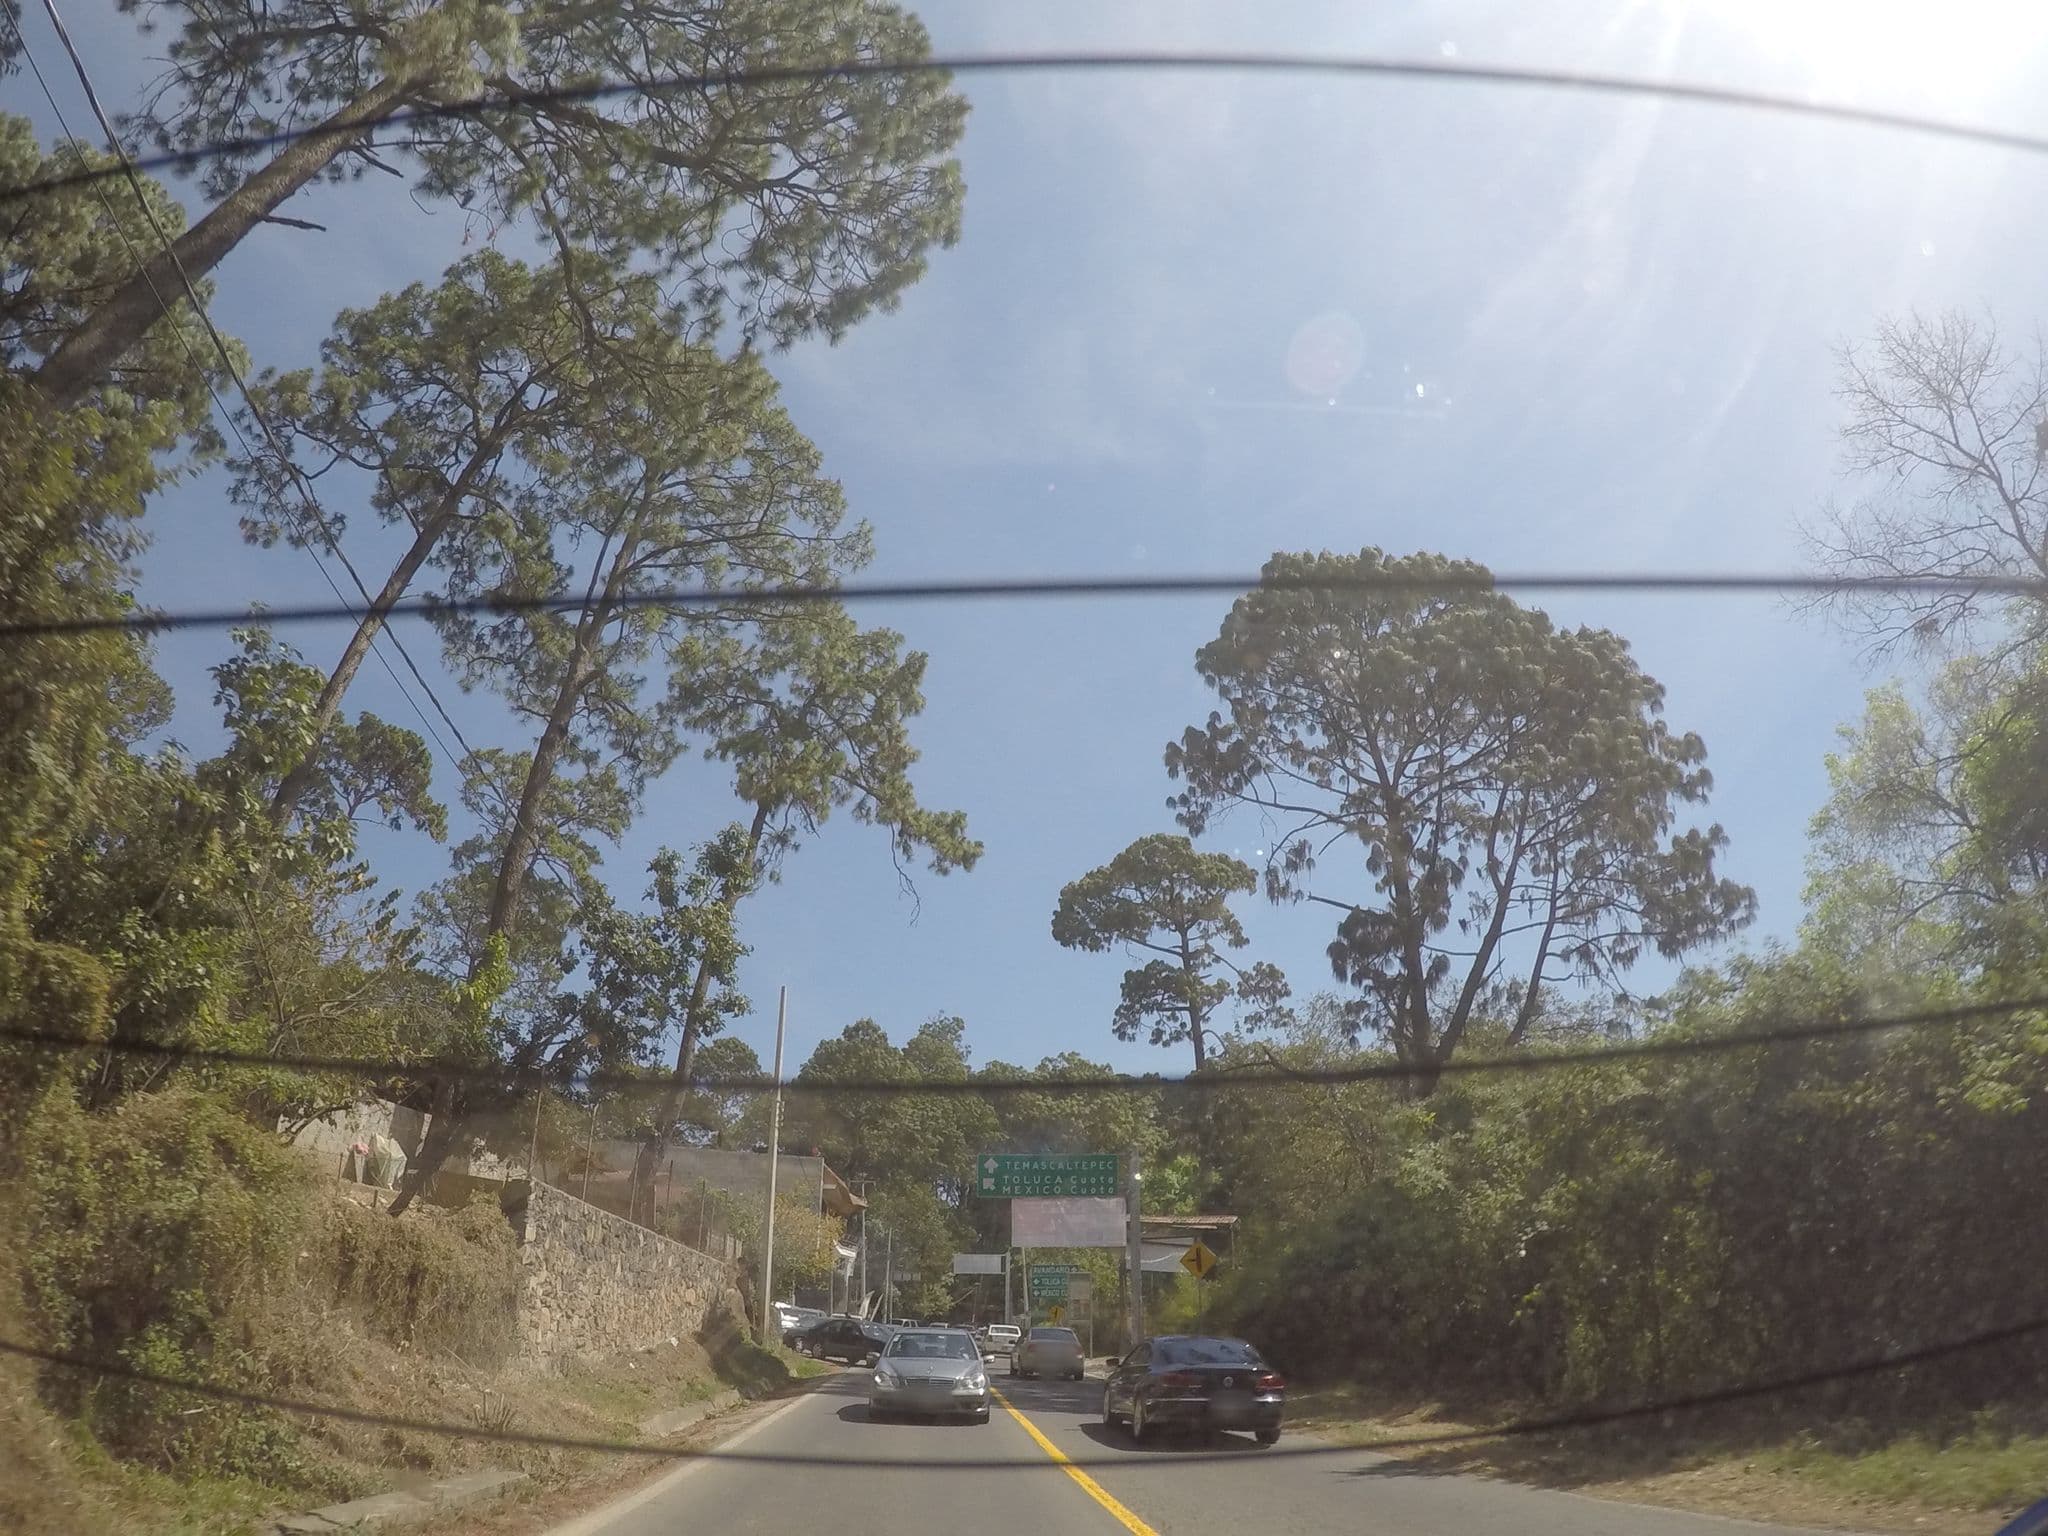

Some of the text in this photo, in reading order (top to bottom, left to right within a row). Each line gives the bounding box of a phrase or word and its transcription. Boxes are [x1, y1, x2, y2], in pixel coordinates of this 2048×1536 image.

[1005, 1161, 1114, 1170] TEMASCALTEPEC
[1002, 1175, 1114, 1184] TOLUCA Cuota
[1002, 1185, 1114, 1194] MEXICO Cuota
